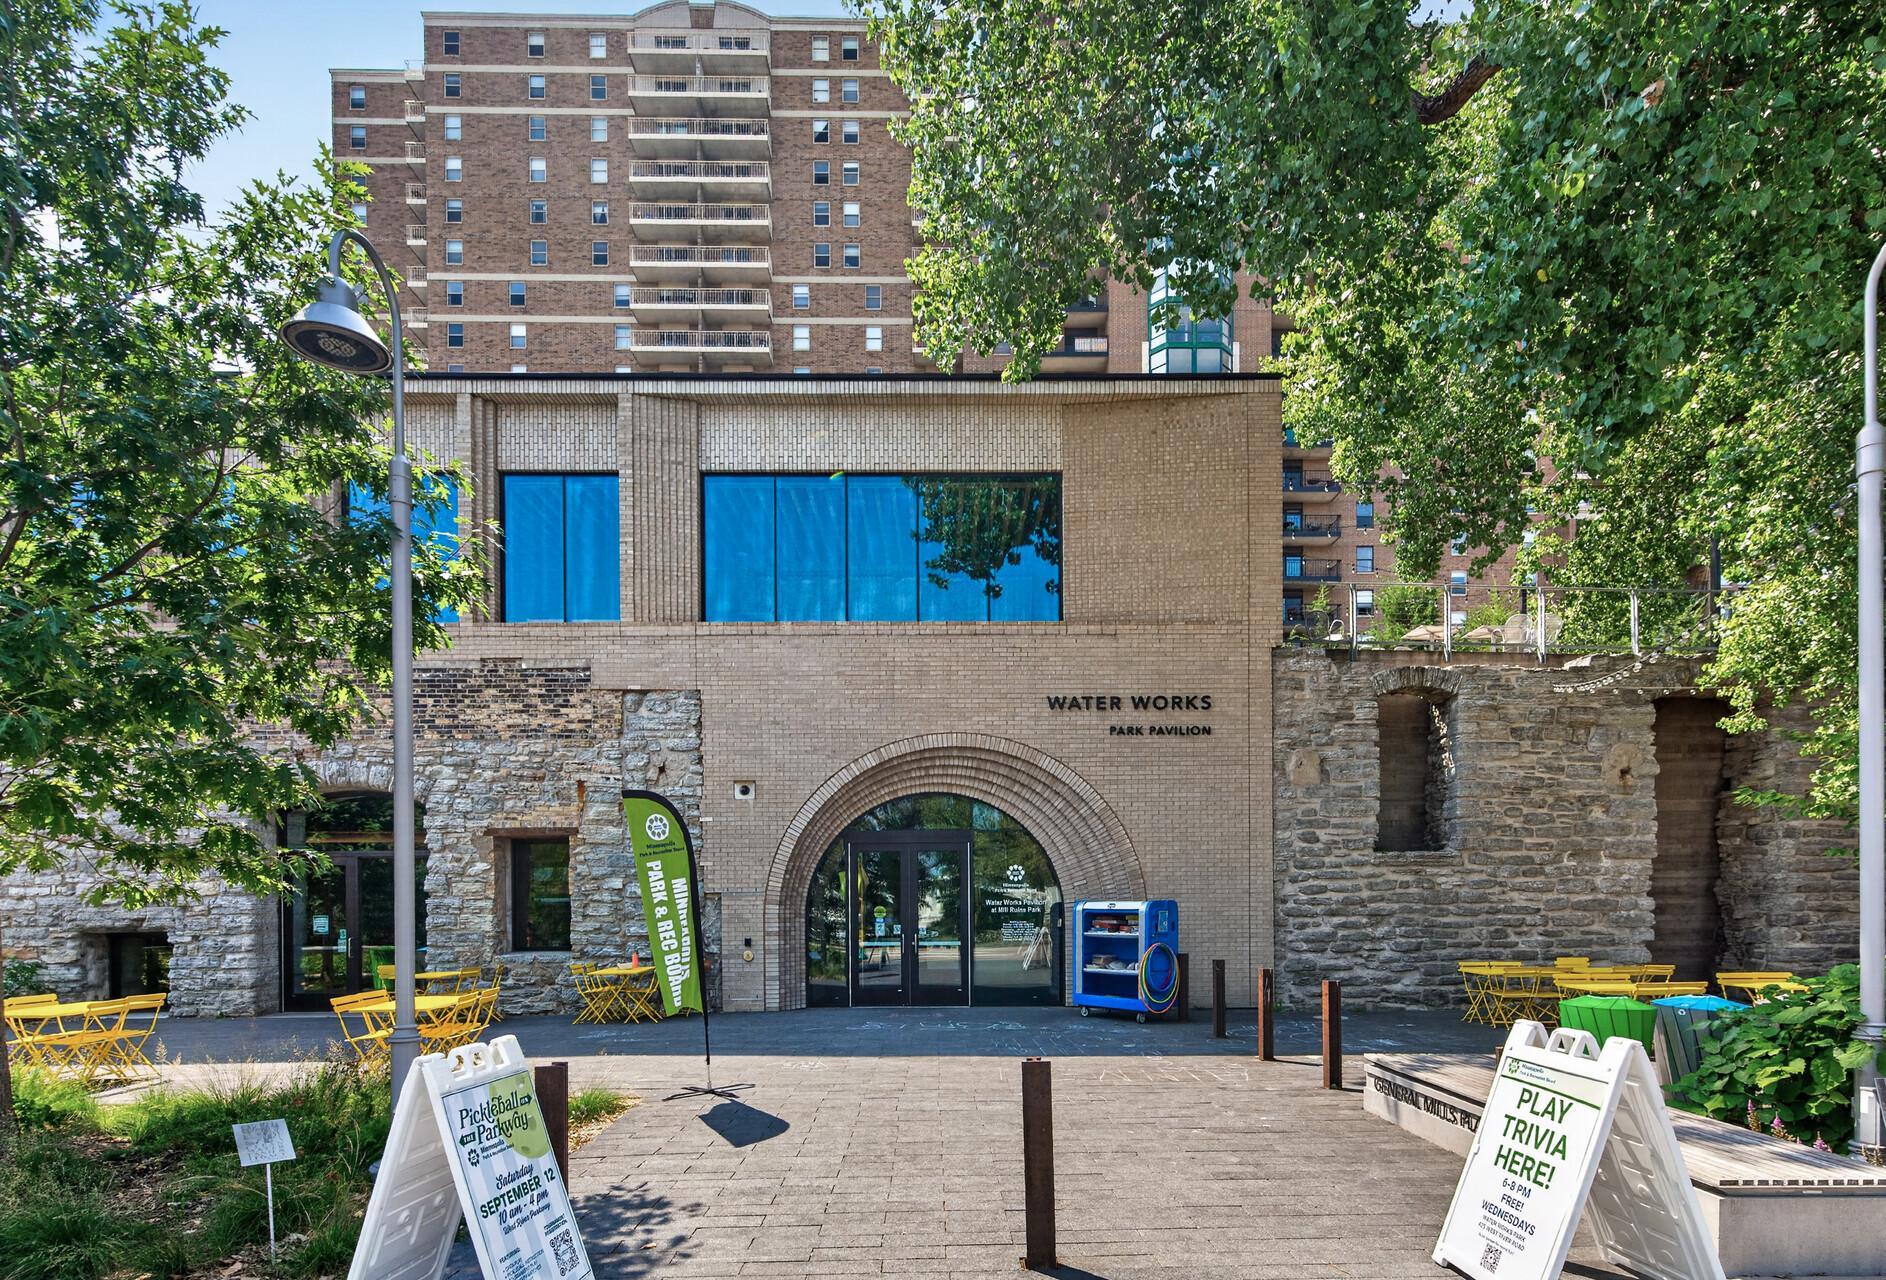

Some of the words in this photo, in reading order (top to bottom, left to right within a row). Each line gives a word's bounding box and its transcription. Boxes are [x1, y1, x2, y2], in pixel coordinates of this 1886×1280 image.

[1047, 695, 1121, 710] WATER
[1131, 695, 1212, 710] WORKS
[1110, 726, 1144, 736] PARK
[1150, 726, 1212, 736] PAVILION
[646, 860, 668, 904] PARK
[654, 906, 668, 919] &
[657, 920, 678, 951] REC
[458, 1090, 519, 1129] Pickleball
[1374, 1077, 1422, 1110] GENERAL
[1423, 1096, 1458, 1125] MILLS
[1516, 1088, 1574, 1124] PLAY
[476, 1111, 528, 1145] Parkway
[1502, 1114, 1566, 1160] TRIVIA
[496, 1164, 534, 1190] Saturday
[1494, 1144, 1556, 1190] HERE!
[480, 1175, 542, 1219] SEPTEMBER
[544, 1168, 556, 1183] 12
[1500, 1194, 1524, 1212] FREE!
[1502, 1178, 1516, 1191] 6-8
[1516, 1184, 1531, 1198] PM
[499, 1209, 507, 1226] 10
[509, 1205, 523, 1219] am
[530, 1193, 534, 1206] 4
[536, 1189, 549, 1206] pm
[516, 1215, 529, 1227] River
[530, 1202, 551, 1219] Parkway
[1482, 1200, 1536, 1236] WEDNESDAYS
[1513, 1231, 1526, 1242] PARK
